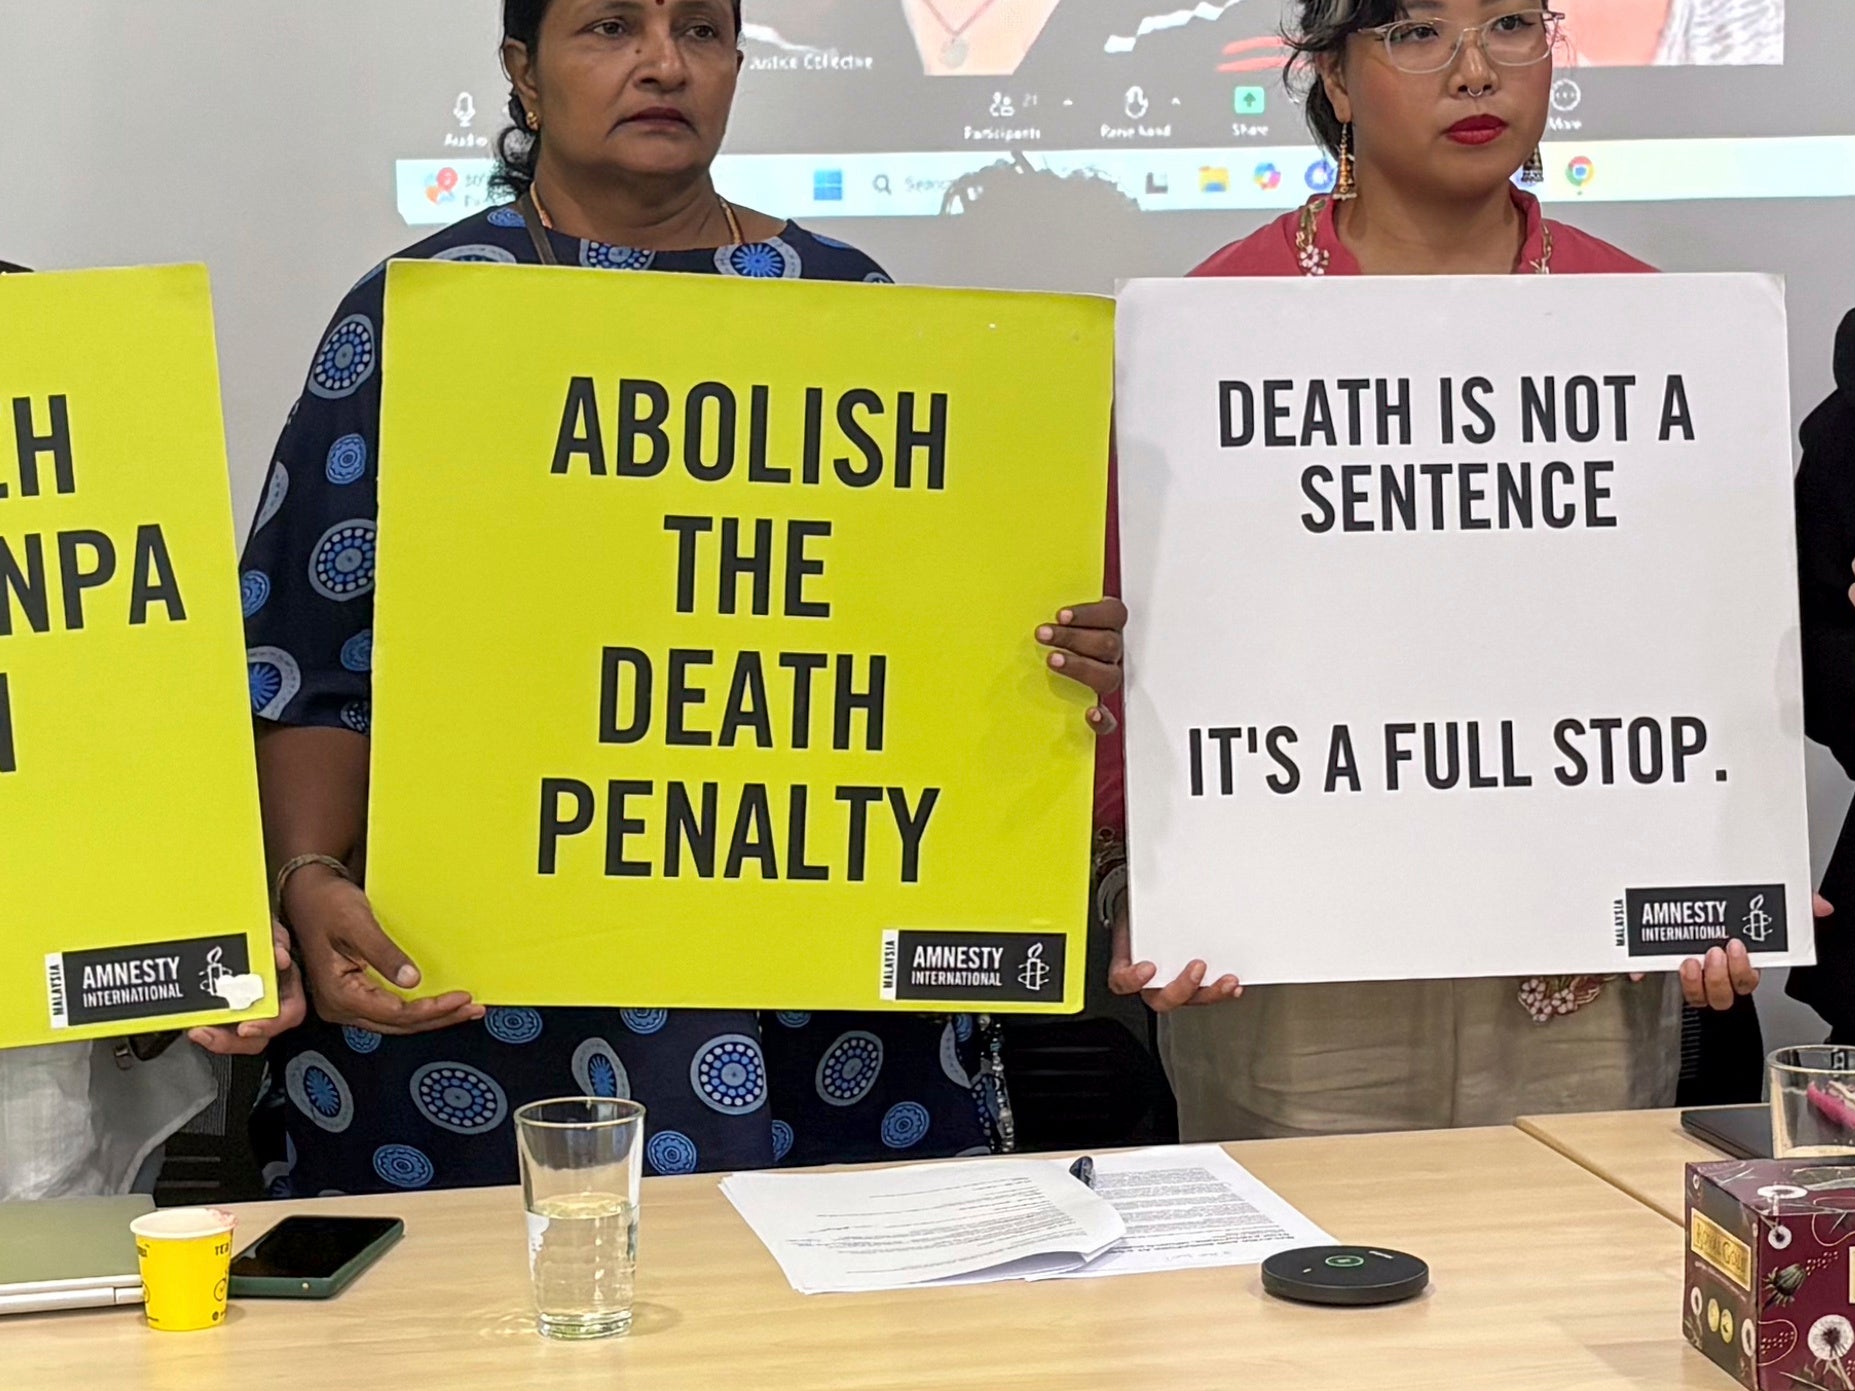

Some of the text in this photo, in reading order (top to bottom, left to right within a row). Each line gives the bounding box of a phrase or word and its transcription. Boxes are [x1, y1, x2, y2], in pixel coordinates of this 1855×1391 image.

[964, 125, 1041, 142] Participants
[1232, 123, 1269, 137] Share
[550, 376, 949, 491] ABOLISH
[1218, 374, 1696, 448] DEATH IS NOT A
[1300, 460, 1618, 533] SENTENCE
[663, 514, 833, 618] THE
[598, 646, 887, 752] DEATH
[1189, 716, 1729, 796] IT'S A FULL STOP.
[536, 777, 941, 883] PENALTY
[1613, 899, 1625, 947] MALAYSIA
[1641, 900, 1727, 925] AMNESTY
[1641, 925, 1730, 942] INTERNATIONAL
[82, 956, 180, 990] AMNESTY
[882, 940, 895, 989] MALAYSIA
[911, 970, 1003, 987] INTERNATIONAL
[912, 945, 1004, 970] AMNESTY
[48, 964, 63, 1016] MALAYSIA
[83, 982, 184, 1008] INTERNATIONAL
